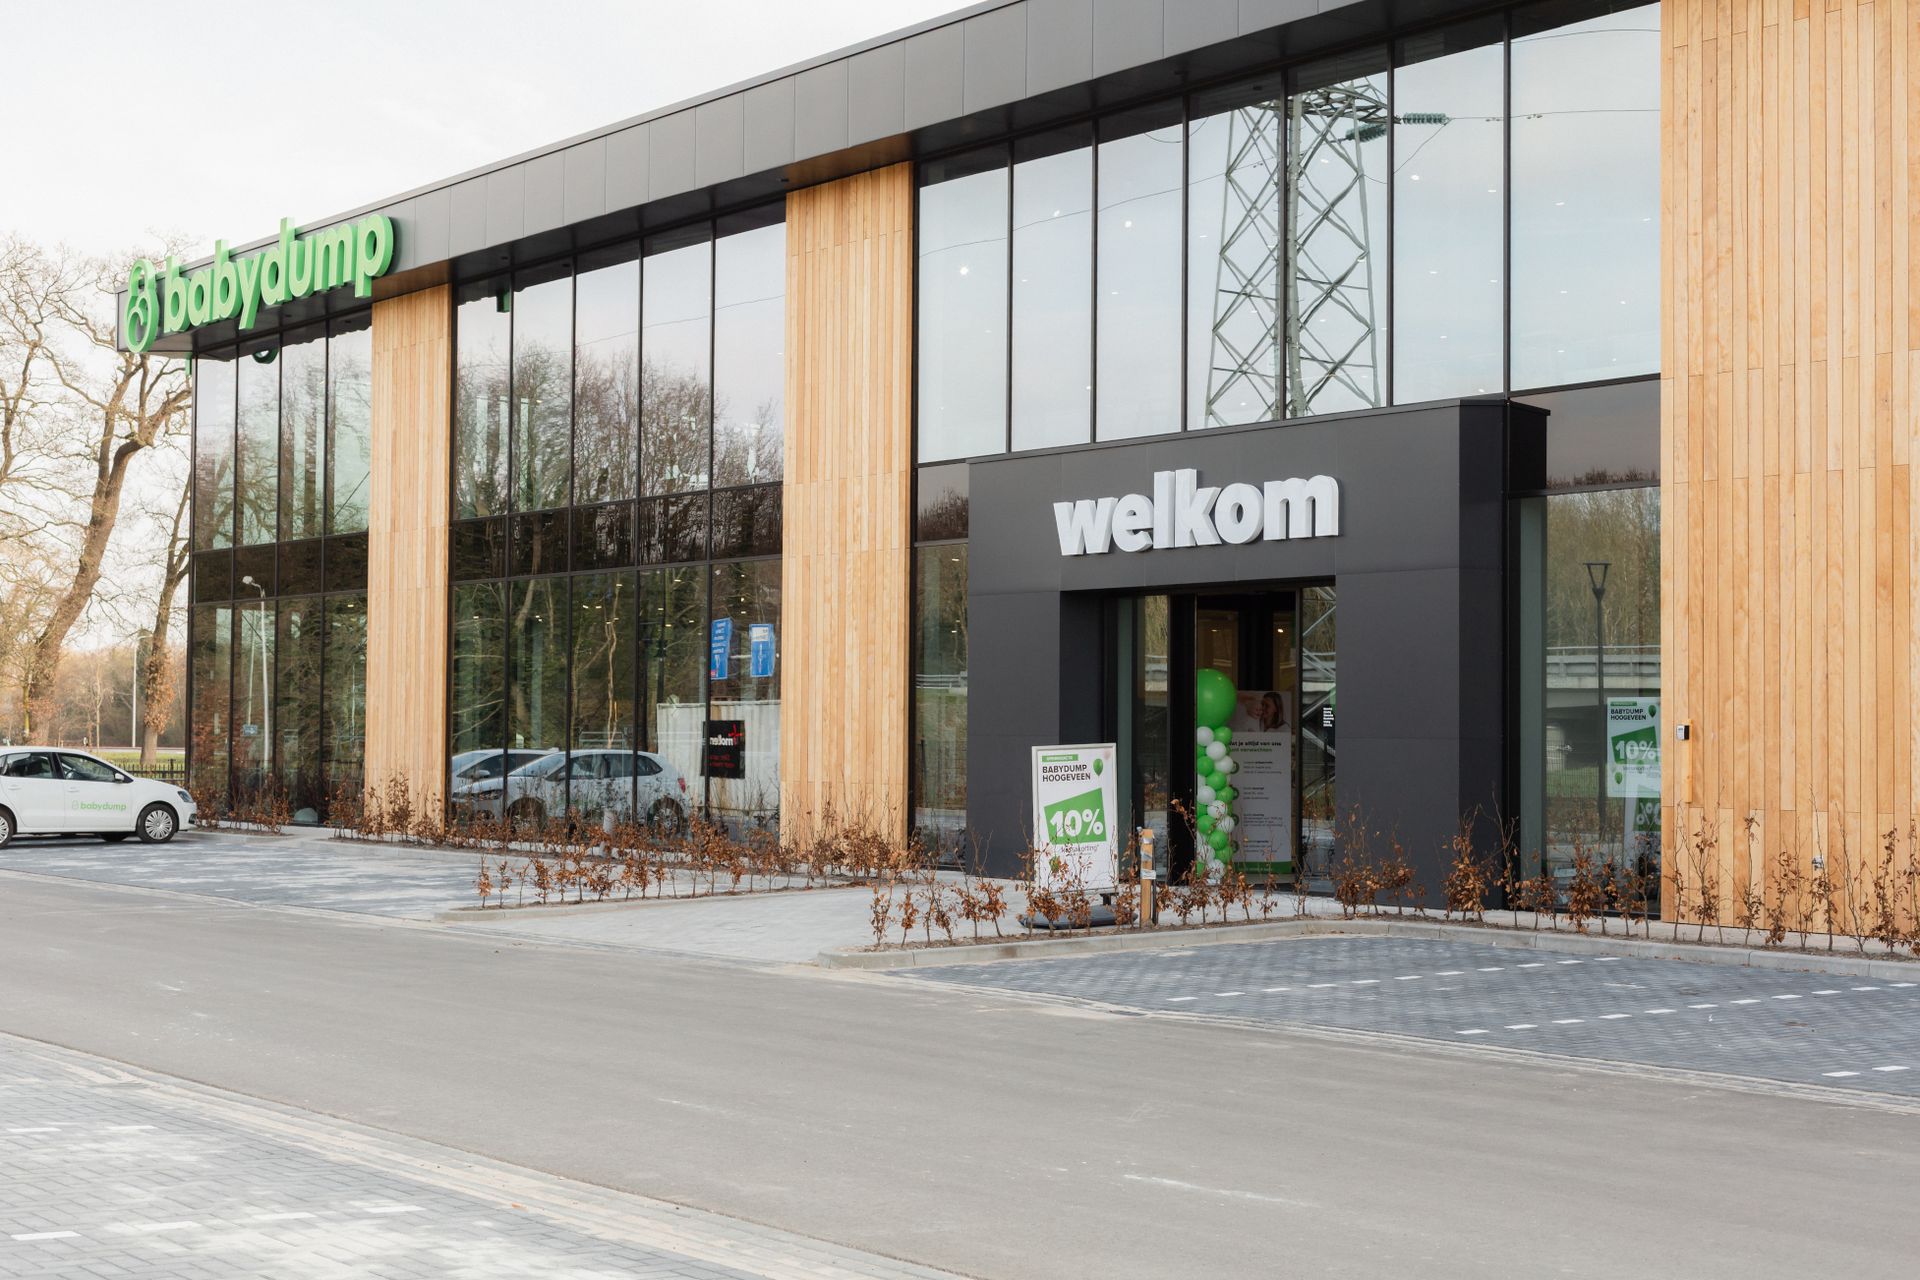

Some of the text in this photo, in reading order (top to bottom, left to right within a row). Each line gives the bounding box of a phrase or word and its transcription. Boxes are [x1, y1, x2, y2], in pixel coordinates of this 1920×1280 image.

[163, 214, 394, 334] babydump
[1053, 468, 1339, 556] welkom
[1615, 740, 1656, 760] 10%
[1042, 764, 1087, 774] BABYDUMP
[1042, 773, 1091, 782] HOOGEVEEN
[80, 802, 127, 811] babydump
[1050, 808, 1104, 837] 10%
